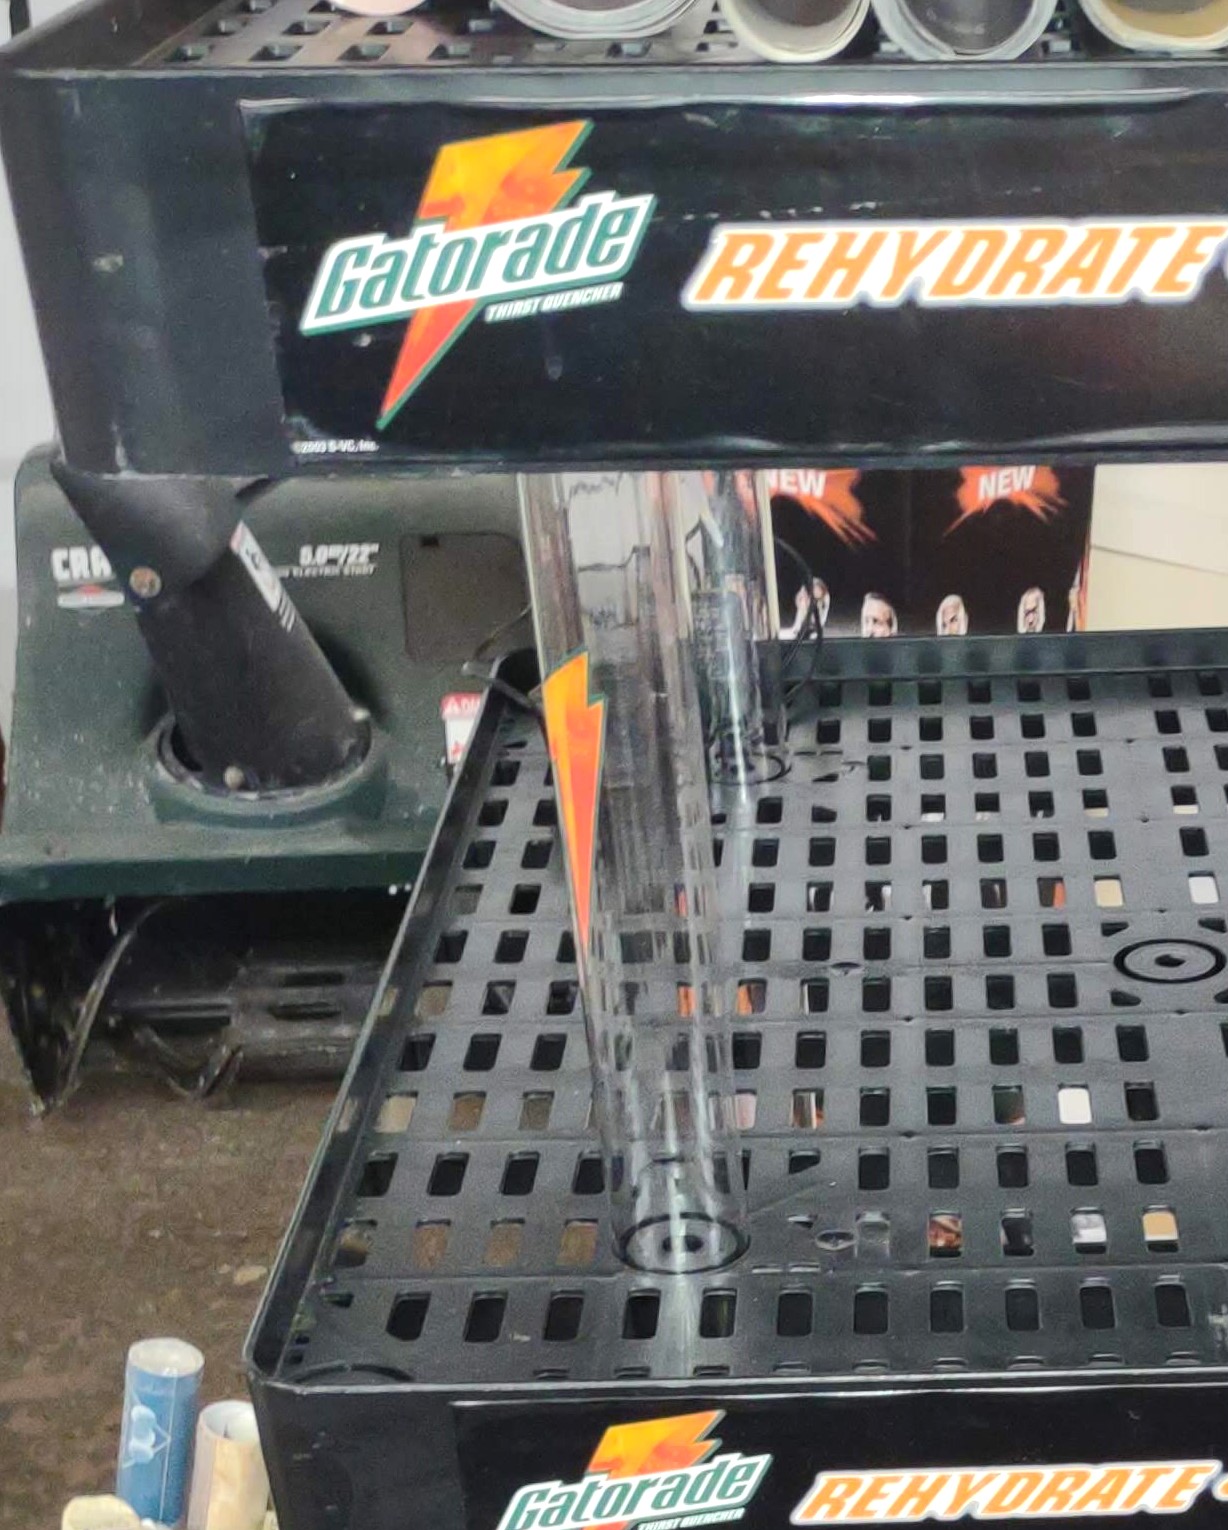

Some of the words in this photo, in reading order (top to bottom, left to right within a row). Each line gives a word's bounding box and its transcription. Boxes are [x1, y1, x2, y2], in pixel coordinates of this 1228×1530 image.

[308, 195, 650, 328] Gatorade
[484, 297, 542, 322] THIRST
[978, 465, 1036, 500] NEW
[793, 1462, 1220, 1523] REHYDRATE
